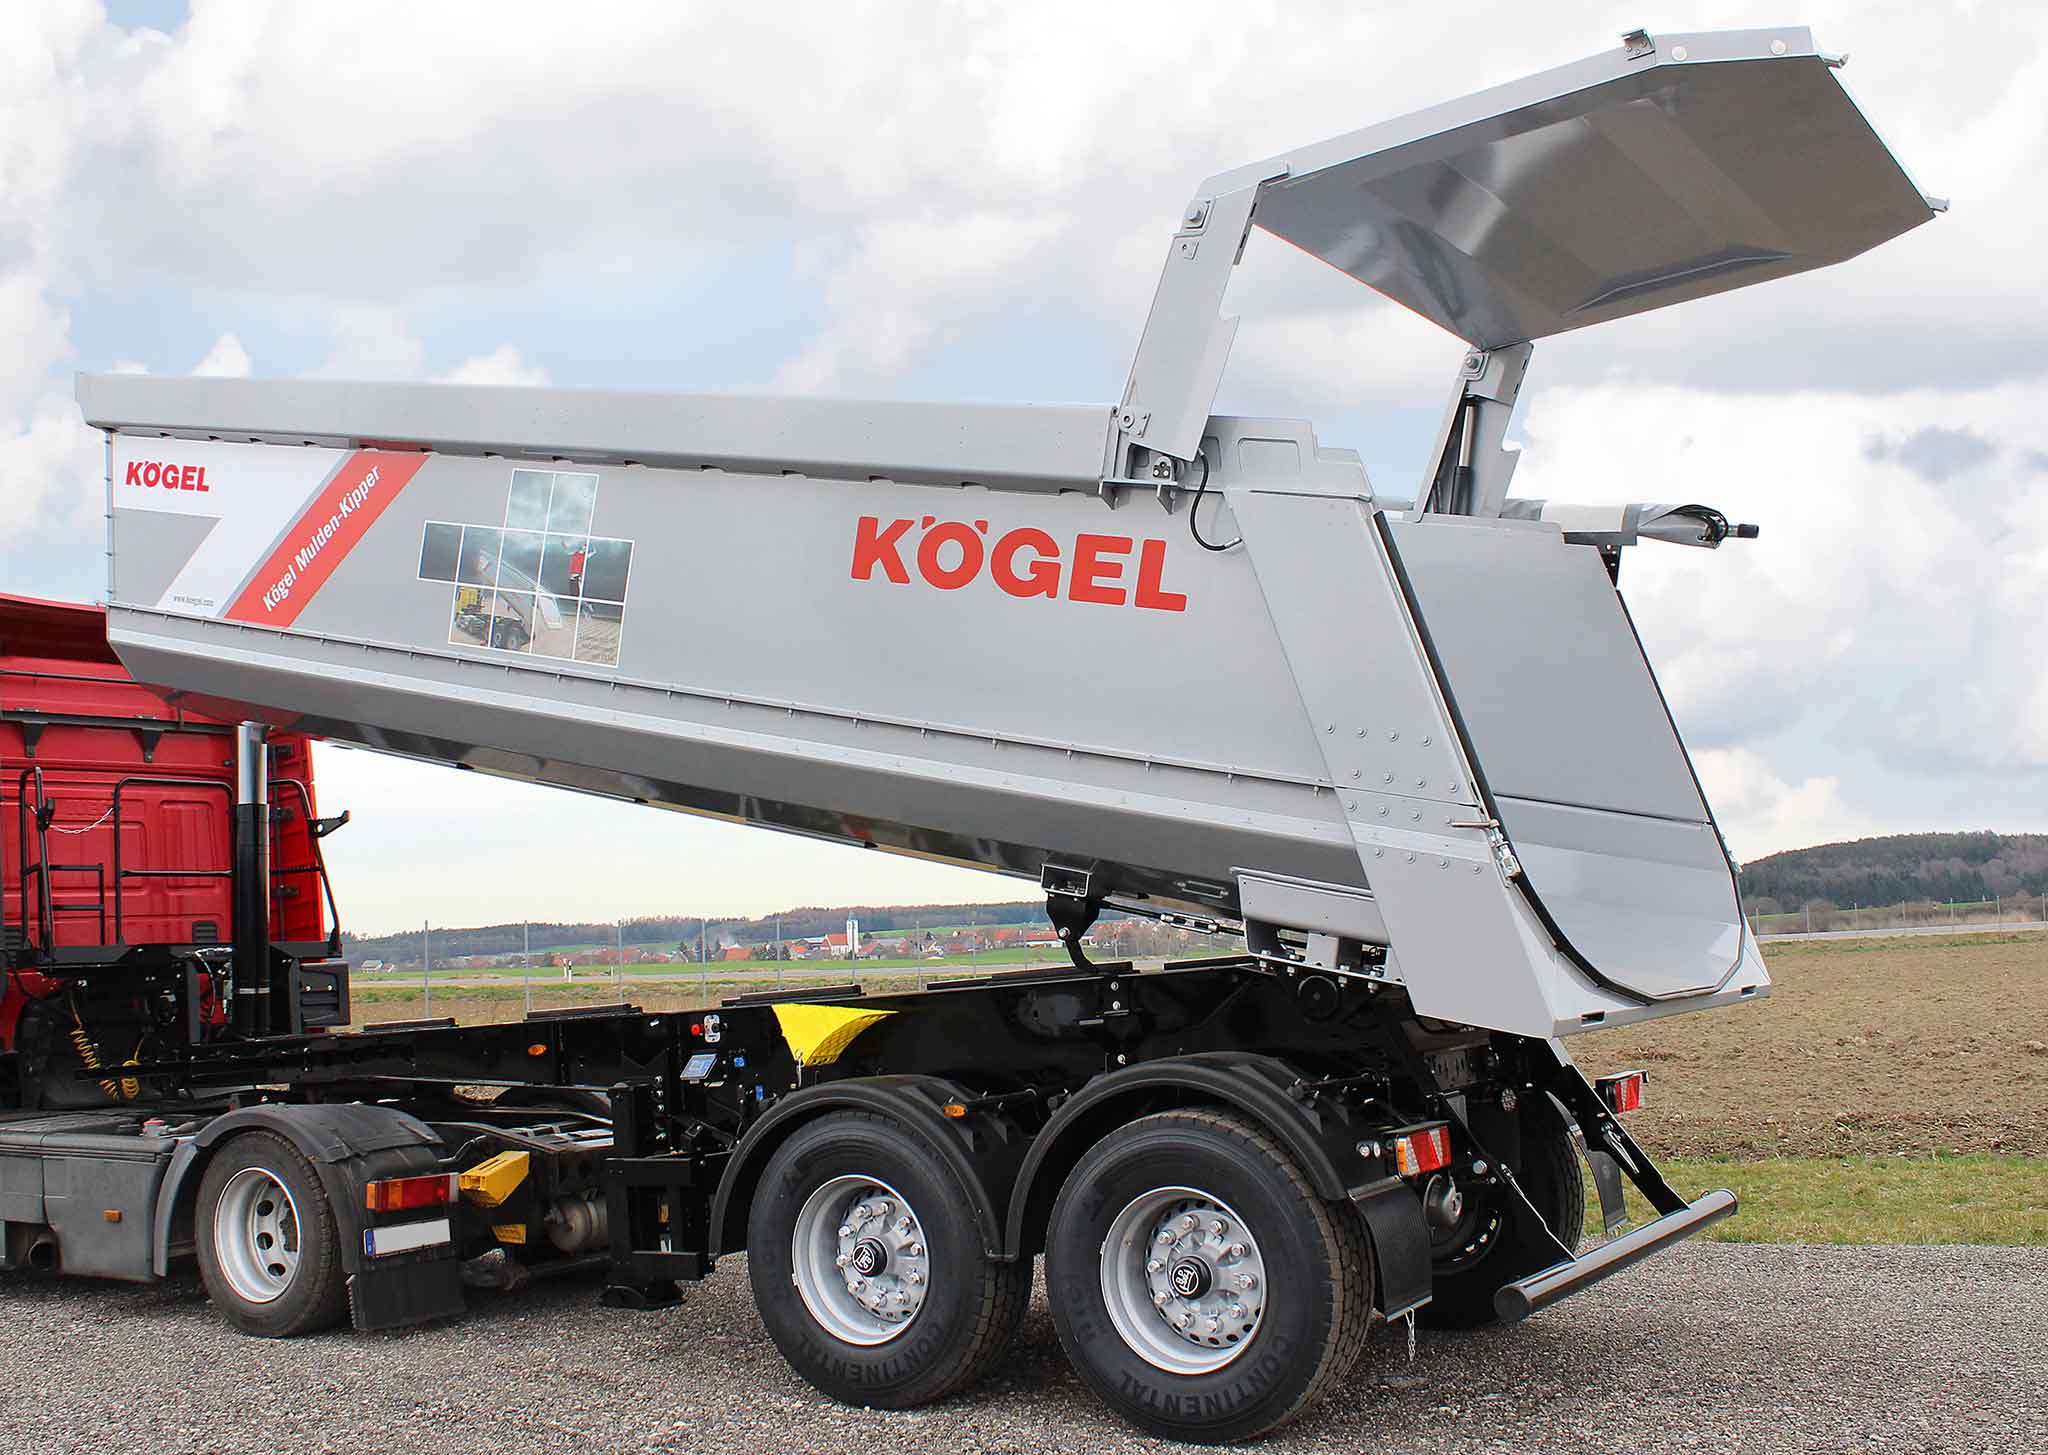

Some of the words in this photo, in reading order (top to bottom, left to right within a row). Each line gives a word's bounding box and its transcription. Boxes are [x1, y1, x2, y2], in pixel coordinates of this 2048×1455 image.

[125, 461, 210, 493] KÖGEL
[262, 564, 298, 613] Kögel
[294, 465, 380, 573] Mulden-Kipper
[850, 515, 1188, 612] KÖGEL
[1116, 1334, 1290, 1418] CONTINENTAL
